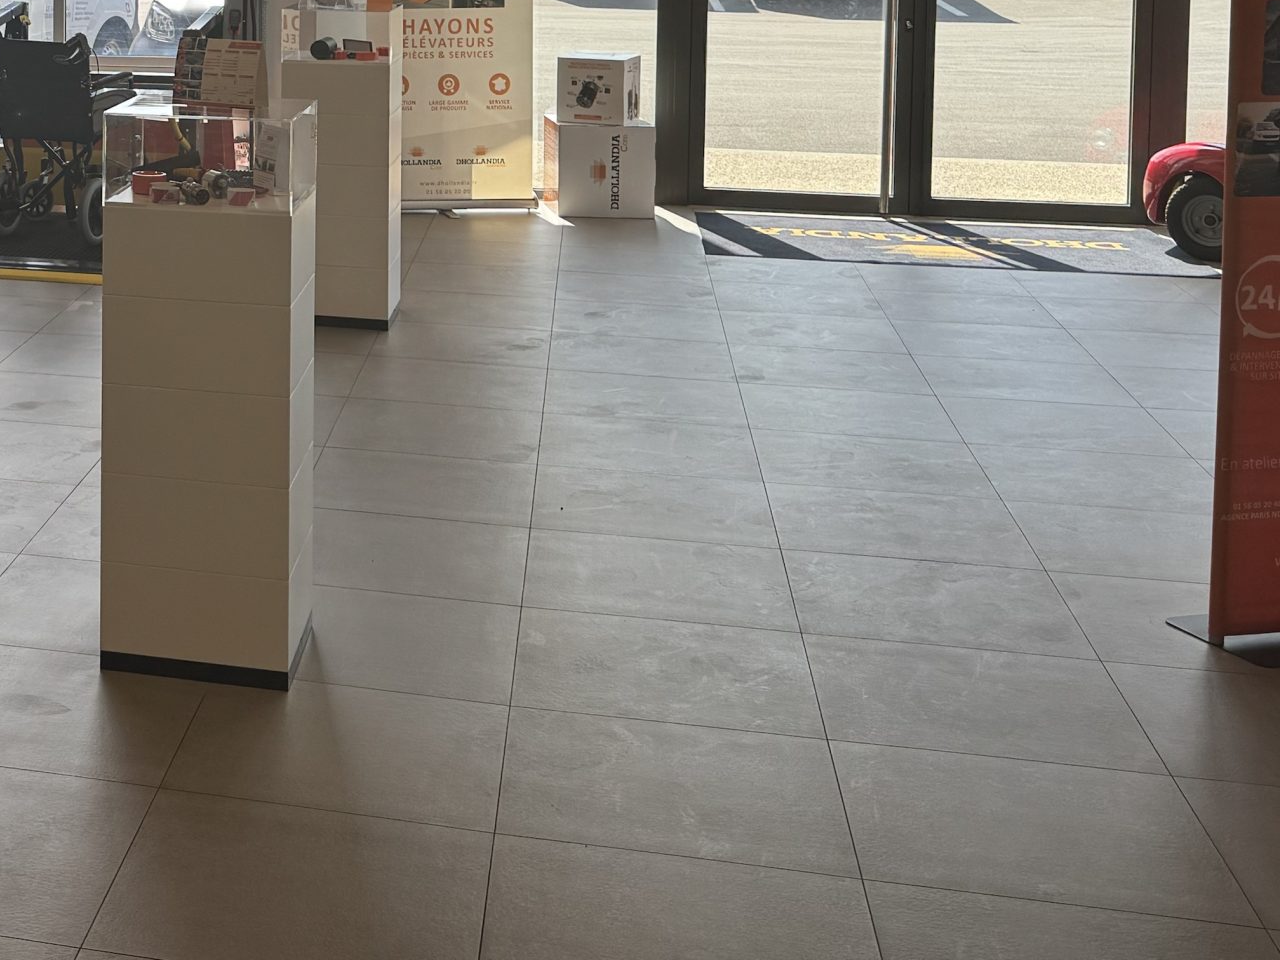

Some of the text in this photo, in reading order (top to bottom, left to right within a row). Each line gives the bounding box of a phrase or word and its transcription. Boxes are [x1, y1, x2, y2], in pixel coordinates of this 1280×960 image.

[402, 17, 495, 35] HAYONS
[402, 35, 495, 49] ÉLÉVATEURS
[402, 48, 494, 60] PIÈCES & SERVICES
[610, 134, 621, 210] DHOLLANDIA
[1241, 285, 1280, 311] 24
[1242, 455, 1280, 470] atelie
